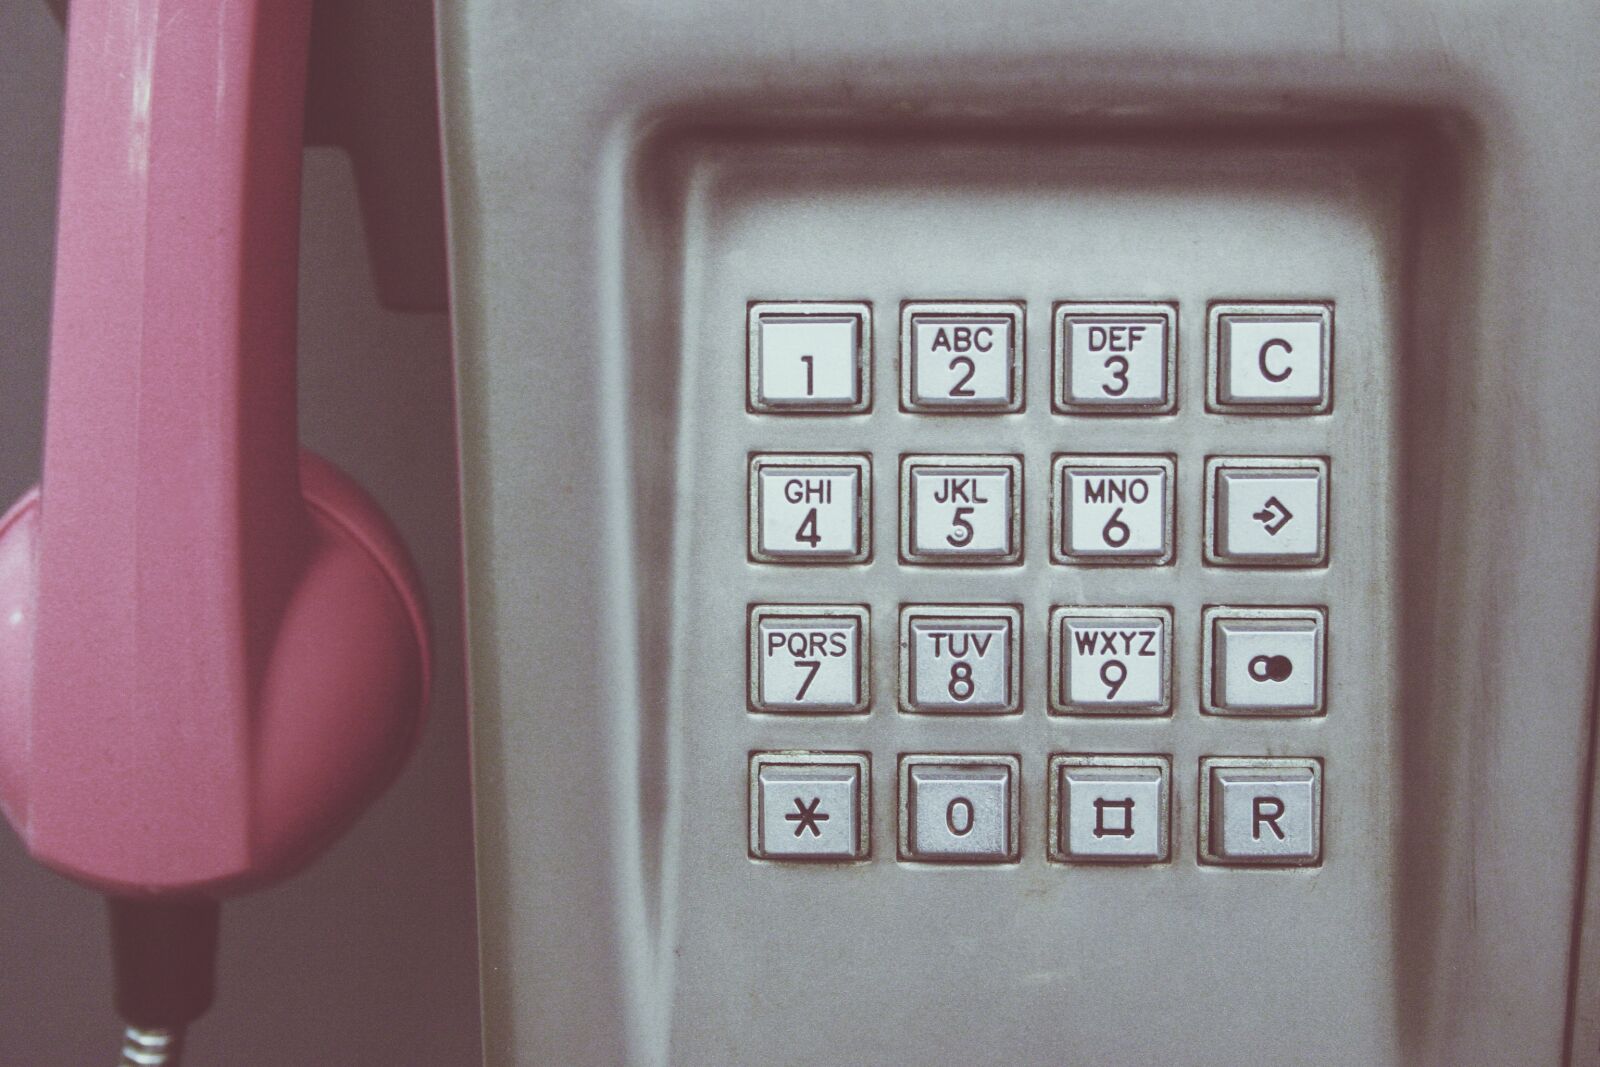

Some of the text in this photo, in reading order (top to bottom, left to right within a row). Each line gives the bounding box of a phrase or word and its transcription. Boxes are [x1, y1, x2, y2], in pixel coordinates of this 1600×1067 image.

[932, 327, 993, 353] ABC
[1089, 326, 1146, 352] DEF
[800, 355, 814, 395] 1
[948, 356, 976, 397] 2
[1101, 355, 1130, 397] 3
[1258, 337, 1293, 383] C
[784, 479, 832, 505] GHI
[934, 479, 989, 504] JKL
[1085, 479, 1149, 504] MNO
[794, 508, 822, 549] 4
[945, 507, 975, 549] 5
[1101, 508, 1131, 549] 6
[767, 632, 847, 659] PQRS
[928, 633, 992, 658] TUV
[1075, 631, 1156, 656] WXYZ
[794, 660, 822, 702] 7
[947, 660, 975, 702] 8
[1100, 659, 1128, 701] 9
[945, 796, 976, 837] 0
[1252, 796, 1286, 840] R
